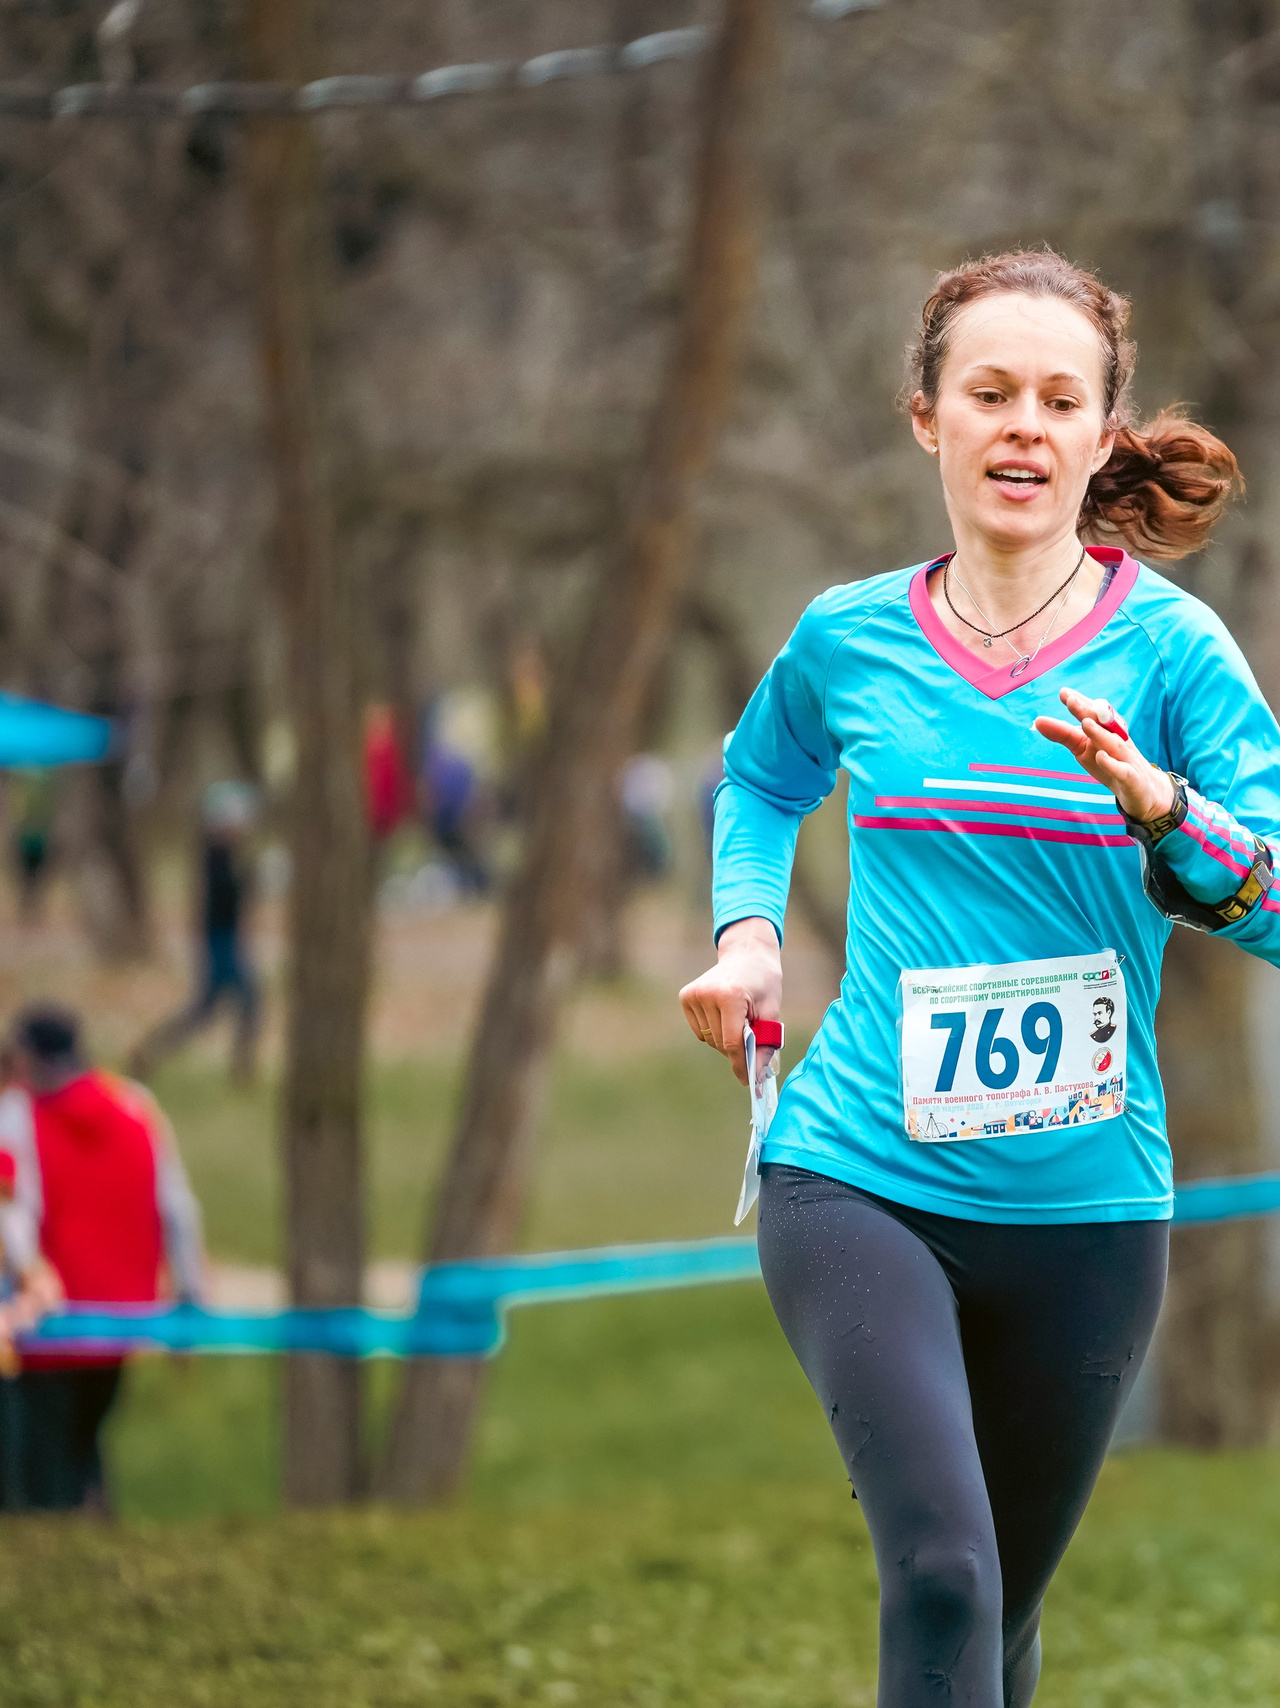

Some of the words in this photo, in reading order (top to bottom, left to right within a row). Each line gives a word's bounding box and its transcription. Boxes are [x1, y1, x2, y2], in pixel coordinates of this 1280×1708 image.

[969, 979, 1019, 992] СПОРТИВНЫЕ
[1021, 972, 1078, 986] СОРЕВНОВАНИЯ
[929, 996, 939, 1005] ПО
[940, 993, 989, 1004] СПОРТИВНОМУ
[991, 985, 1061, 1000] ОРИЕНТИРОВАНИЮ
[930, 1001, 1063, 1092] 769
[912, 1096, 942, 1105] Памяти
[944, 1094, 983, 1104] военного
[985, 1089, 1031, 1101] топографа
[1033, 1087, 1041, 1096] А.
[1044, 1086, 1052, 1095] В.
[1054, 1080, 1094, 1093] Пастухова
